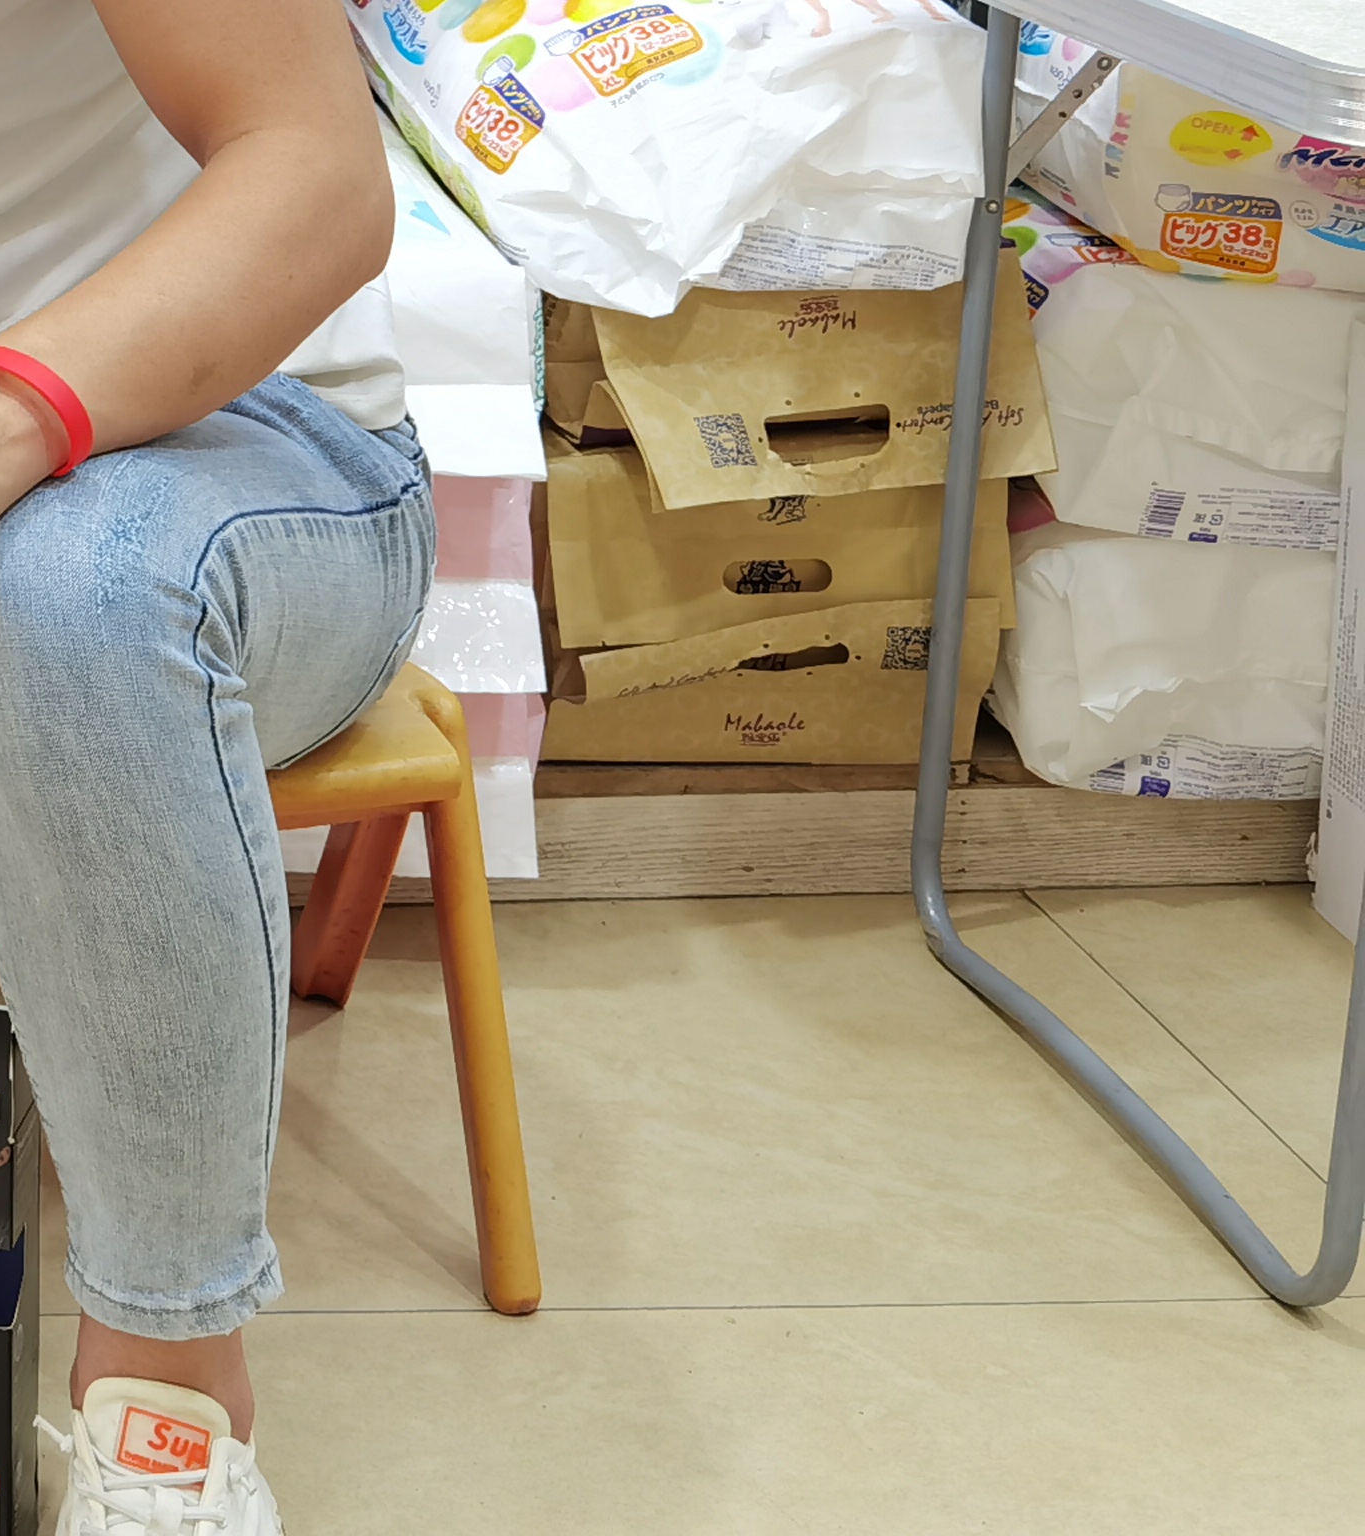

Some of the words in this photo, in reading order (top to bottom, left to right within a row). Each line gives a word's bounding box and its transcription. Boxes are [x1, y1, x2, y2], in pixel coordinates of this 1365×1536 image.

[1191, 116, 1235, 136] OPEN
[1169, 217, 1220, 247] ビッグ
[1223, 222, 1262, 246] 38
[724, 712, 806, 732] Mabaole
